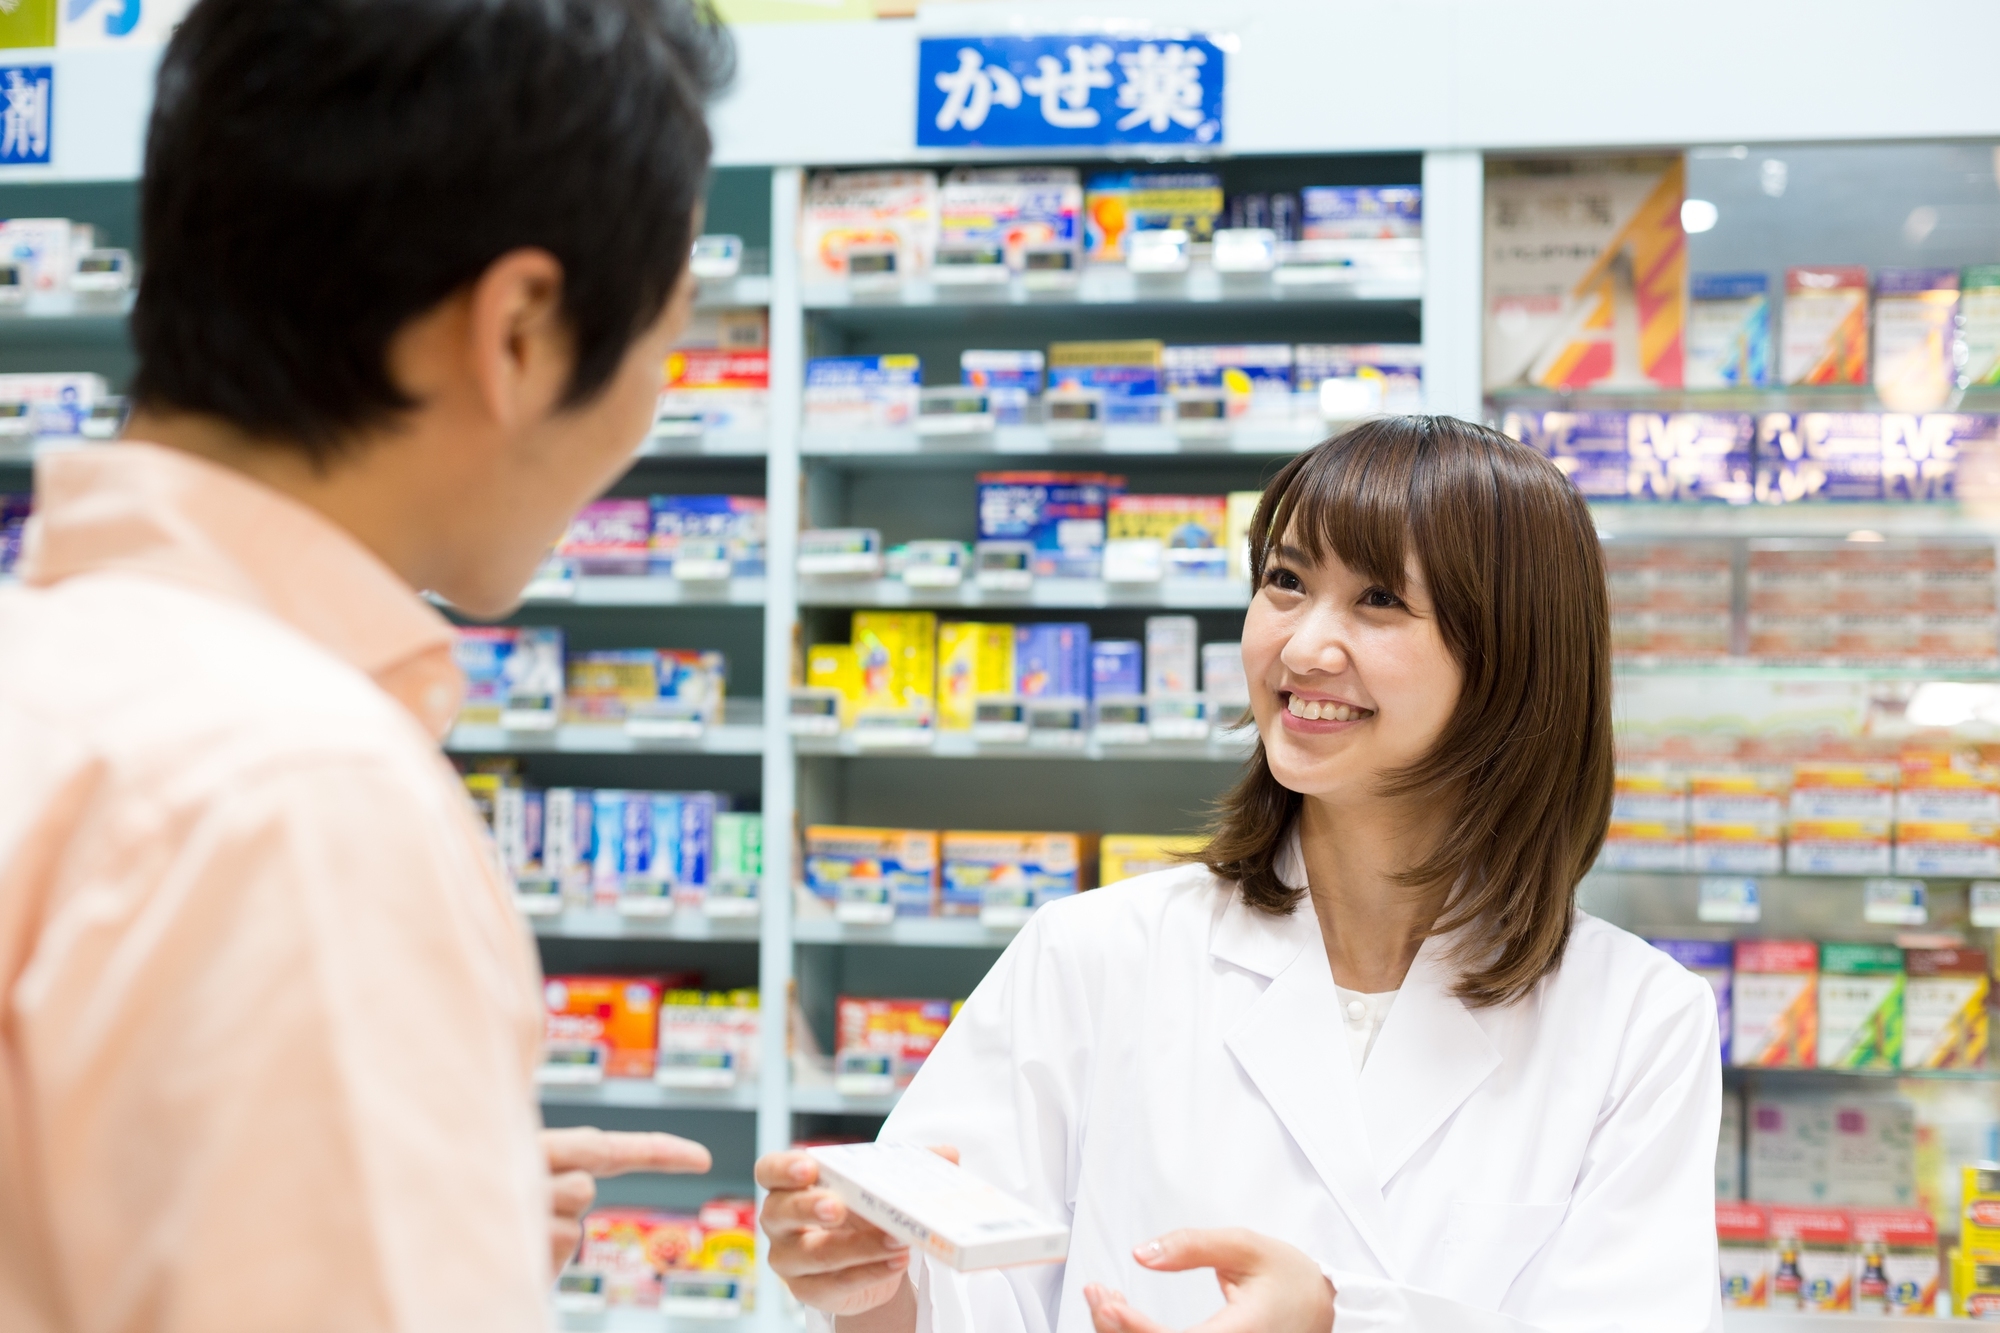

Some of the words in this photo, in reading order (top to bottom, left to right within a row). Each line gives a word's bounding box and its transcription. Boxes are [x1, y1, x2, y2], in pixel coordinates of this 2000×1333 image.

[0, 69, 49, 158] 剤
[935, 44, 1207, 132] かぜ薬
